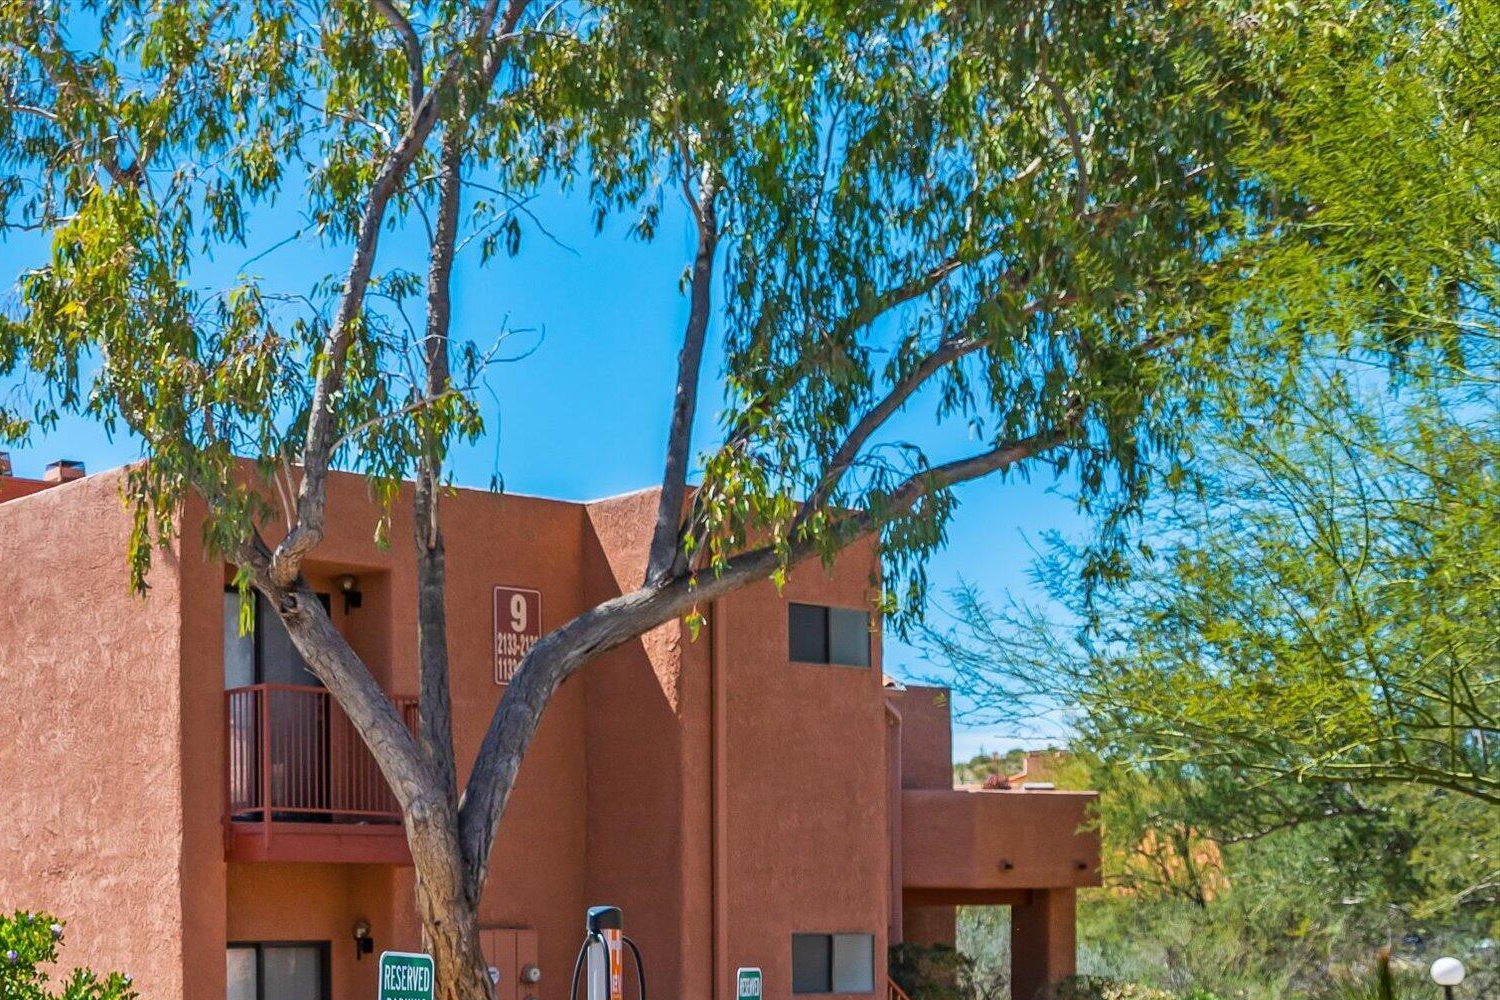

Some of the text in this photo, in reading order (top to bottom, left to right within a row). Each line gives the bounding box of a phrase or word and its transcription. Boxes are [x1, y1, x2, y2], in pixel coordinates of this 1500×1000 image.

[510, 593, 527, 632] 9
[384, 964, 430, 992] RESERVED
[739, 977, 760, 996] RESERVED
